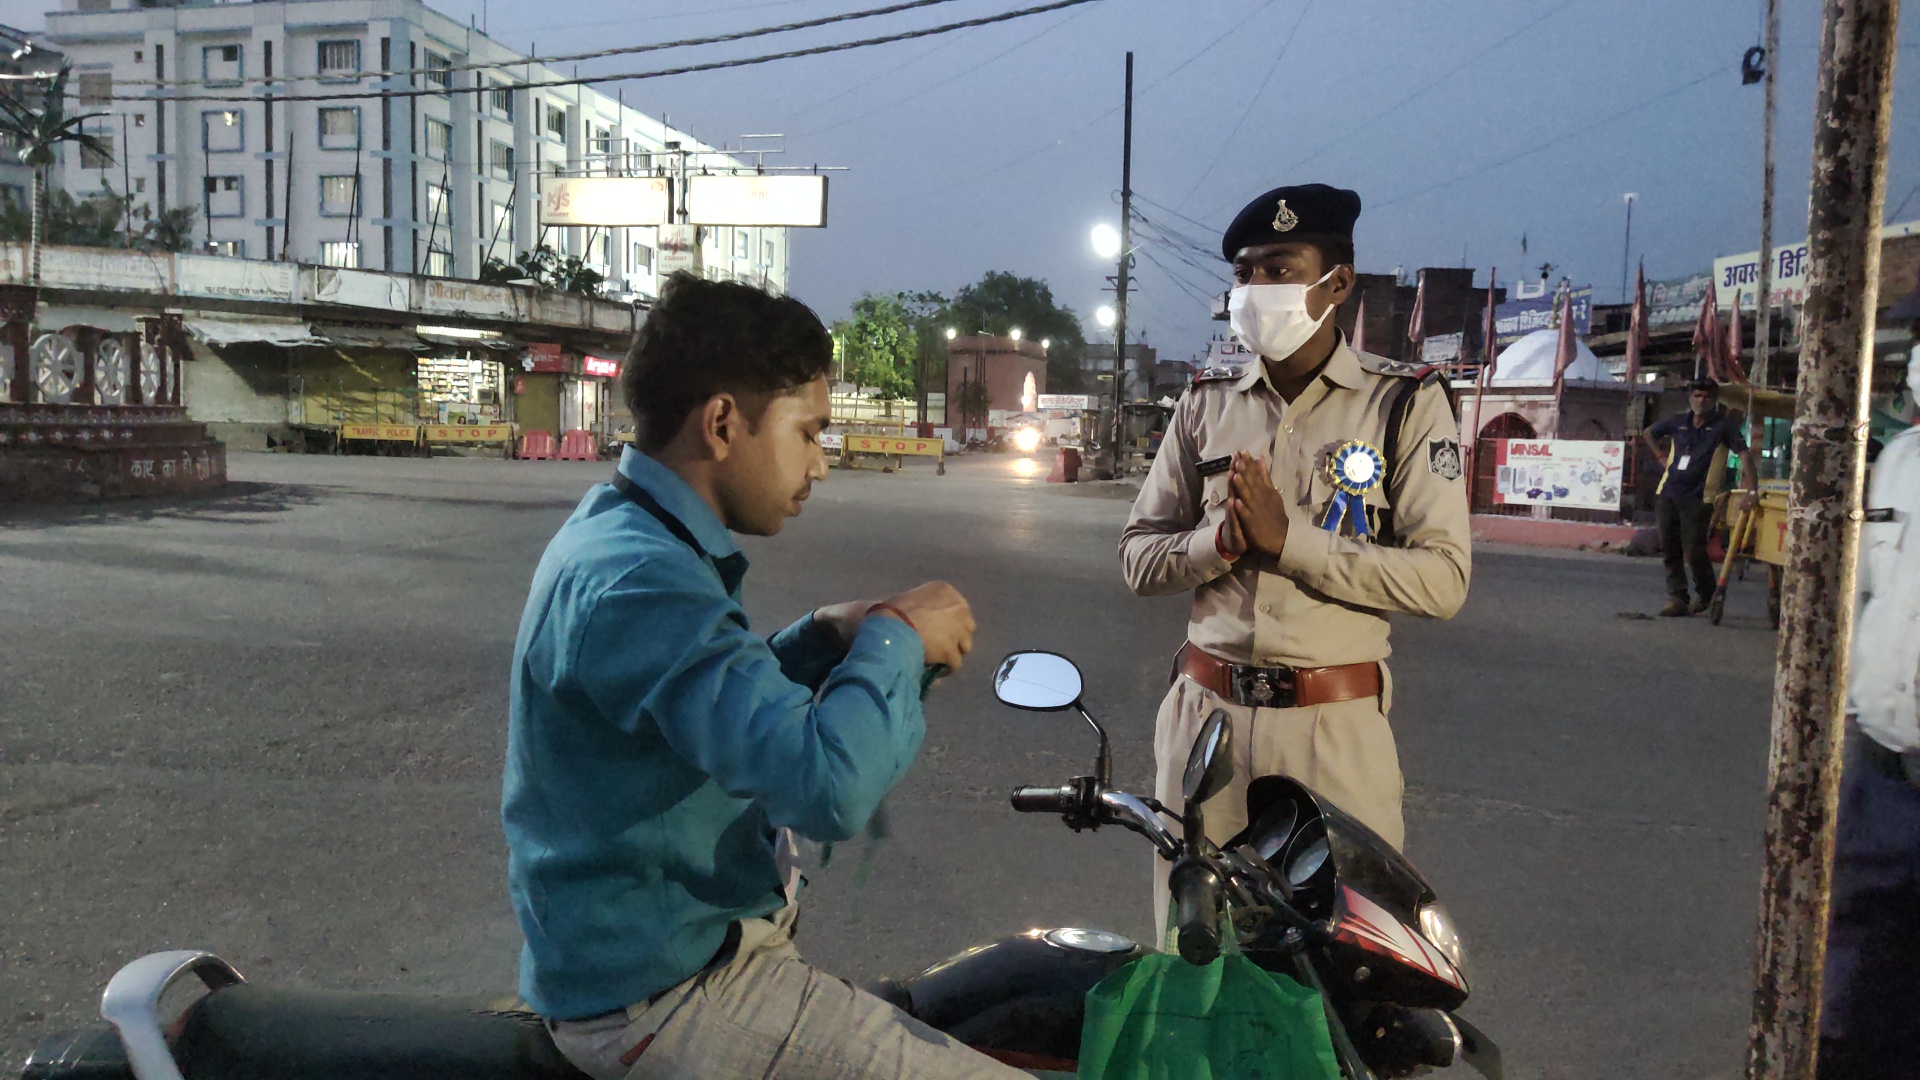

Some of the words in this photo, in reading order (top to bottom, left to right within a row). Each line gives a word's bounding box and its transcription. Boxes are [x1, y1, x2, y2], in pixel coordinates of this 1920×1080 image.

[351, 427, 380, 437] TRAFFIC
[386, 428, 411, 438] POLICE
[437, 429, 498, 439] STOP
[860, 438, 928, 451] STOP
